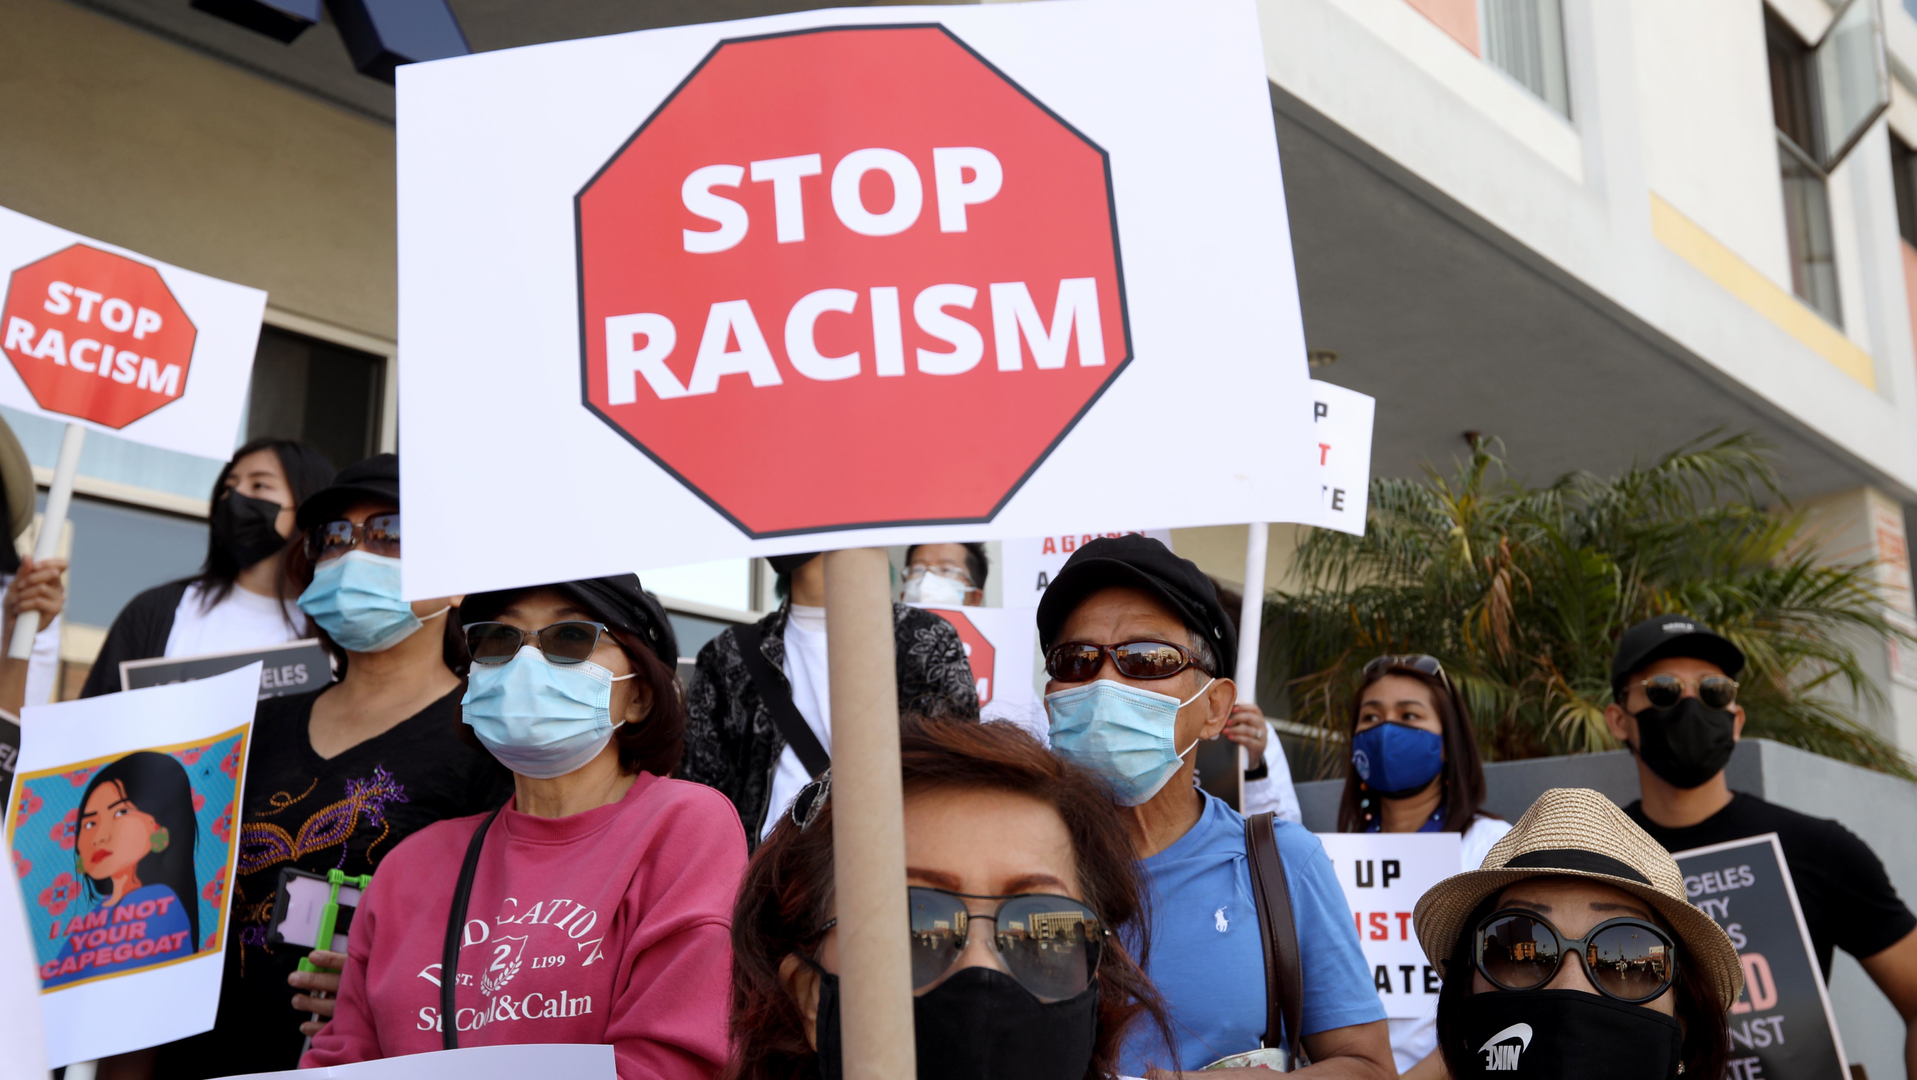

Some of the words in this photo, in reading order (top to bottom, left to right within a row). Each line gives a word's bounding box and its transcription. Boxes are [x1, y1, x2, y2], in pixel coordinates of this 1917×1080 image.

[681, 146, 1004, 254] STOP
[43, 281, 163, 340] STOP
[4, 316, 181, 397] RACISM
[605, 277, 1106, 406] RACISM
[260, 664, 309, 690] ELES
[1355, 860, 1401, 889] UP
[1684, 865, 1755, 897] GELES
[49, 920, 61, 939] I
[63, 909, 109, 936] AM
[112, 896, 175, 924] NOT
[70, 921, 147, 952] YOUR
[38, 930, 188, 980] CAPEGOAT
[490, 944, 511, 972] 2
[1374, 965, 1440, 994] ATE
[1486, 1045, 1521, 1070] NIKE
